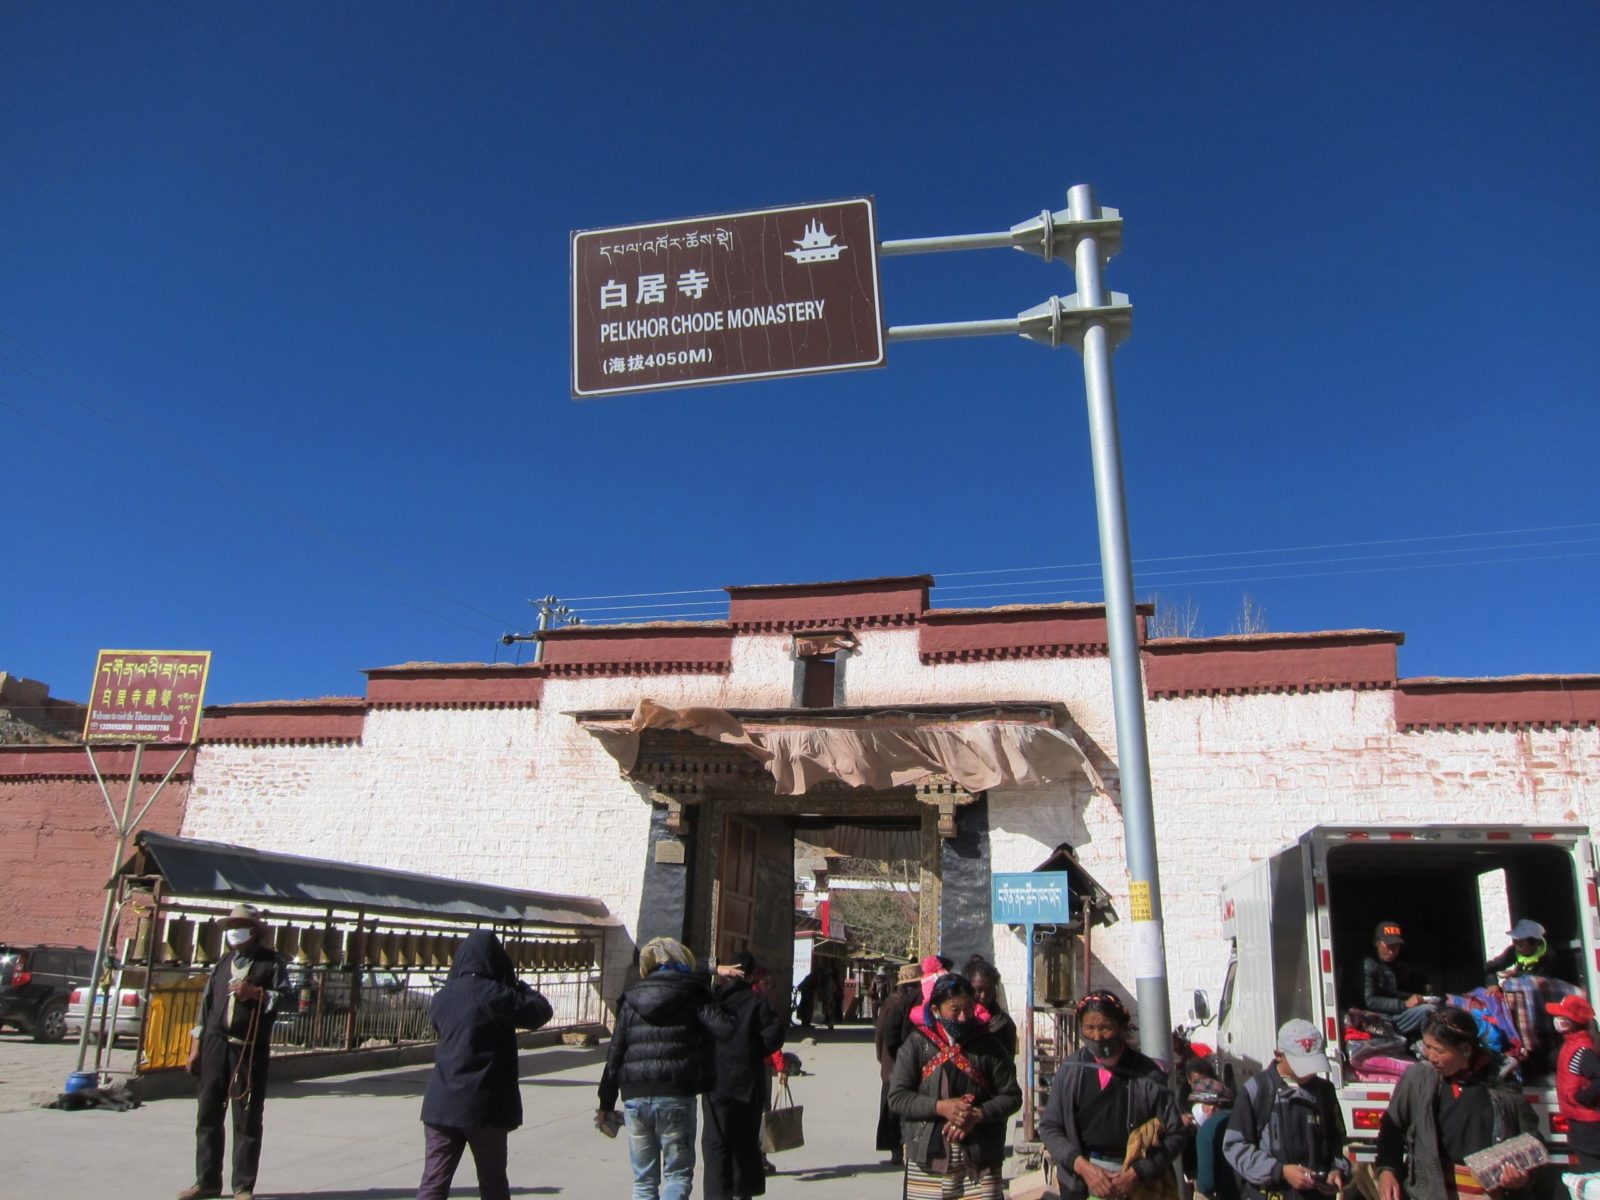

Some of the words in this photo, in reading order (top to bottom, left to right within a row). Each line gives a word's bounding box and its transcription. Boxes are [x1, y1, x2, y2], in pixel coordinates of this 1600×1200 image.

[600, 269, 709, 310] 白居寺
[601, 316, 669, 343] PELKHOR
[671, 311, 723, 336] CHODE
[727, 300, 825, 329] MONASTERY
[602, 348, 713, 375] (海拔4050M)
